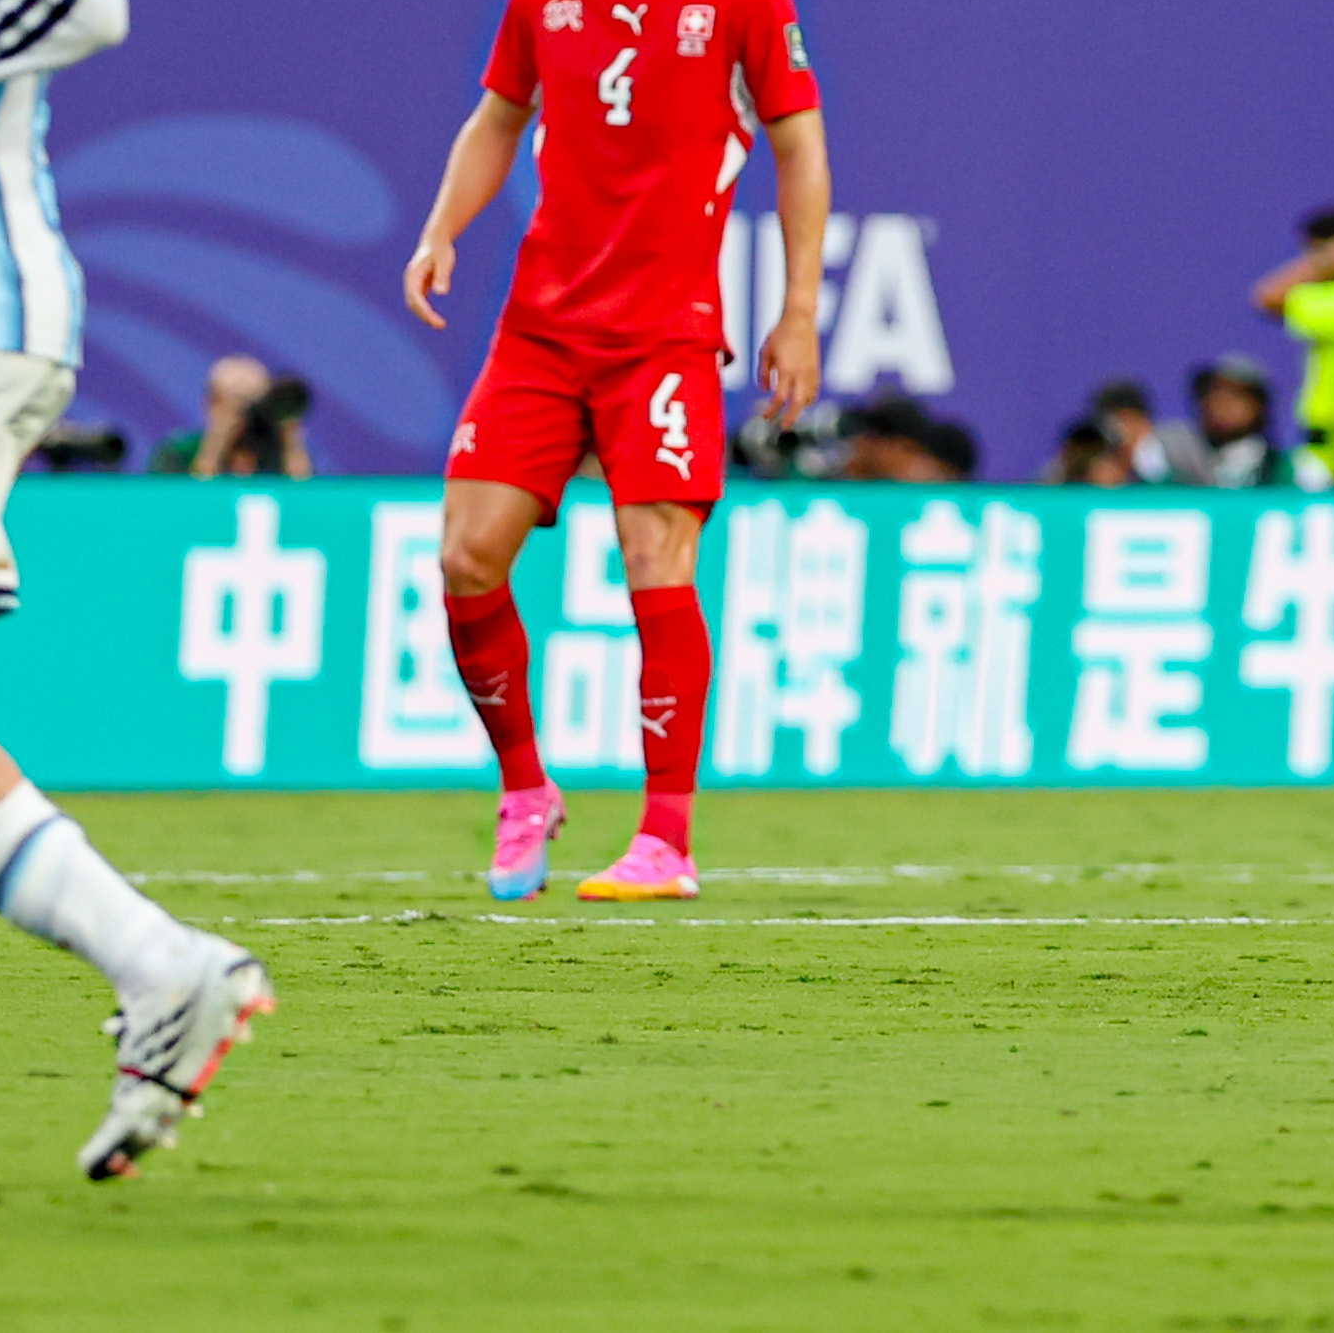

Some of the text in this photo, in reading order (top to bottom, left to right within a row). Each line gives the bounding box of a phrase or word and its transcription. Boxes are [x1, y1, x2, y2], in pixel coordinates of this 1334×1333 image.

[598, 47, 638, 126] 4
[717, 209, 956, 395] IFA
[649, 372, 689, 448] 4
